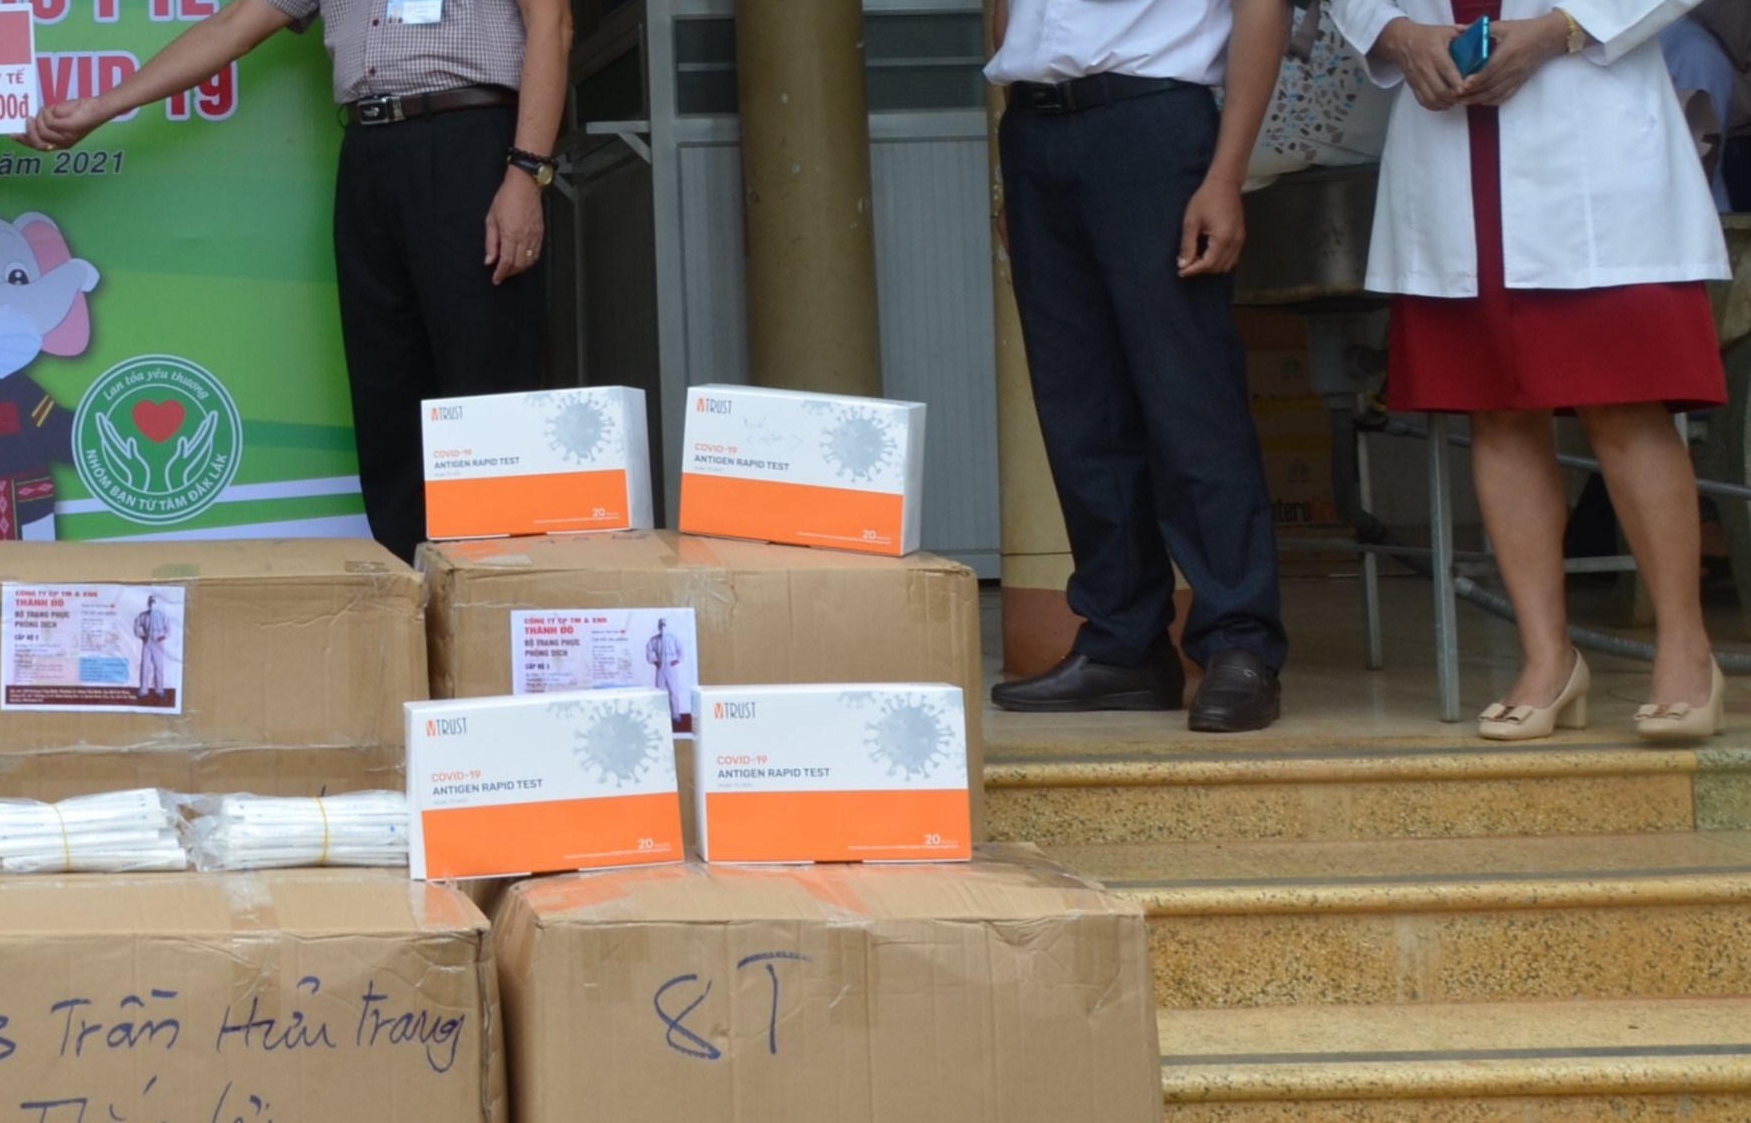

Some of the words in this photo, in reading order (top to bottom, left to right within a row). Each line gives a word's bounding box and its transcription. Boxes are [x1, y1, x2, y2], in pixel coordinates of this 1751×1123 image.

[7, 67, 26, 85] TẾ
[52, 150, 125, 175] 2021
[102, 382, 124, 402] Lan
[85, 447, 113, 494] NHÓM
[109, 482, 136, 507] BẠN
[159, 492, 188, 513] TÂM
[717, 754, 768, 766] COVID-19
[432, 770, 482, 783] COVID-19
[717, 768, 765, 779] ANTIGEN
[767, 767, 802, 779] RAPID
[803, 767, 830, 778] TEST
[432, 782, 481, 796] ANTIGEN
[481, 780, 516, 793] RAPID
[516, 778, 544, 790] TEST
[637, 838, 655, 851] 20
[923, 833, 941, 846] 20
